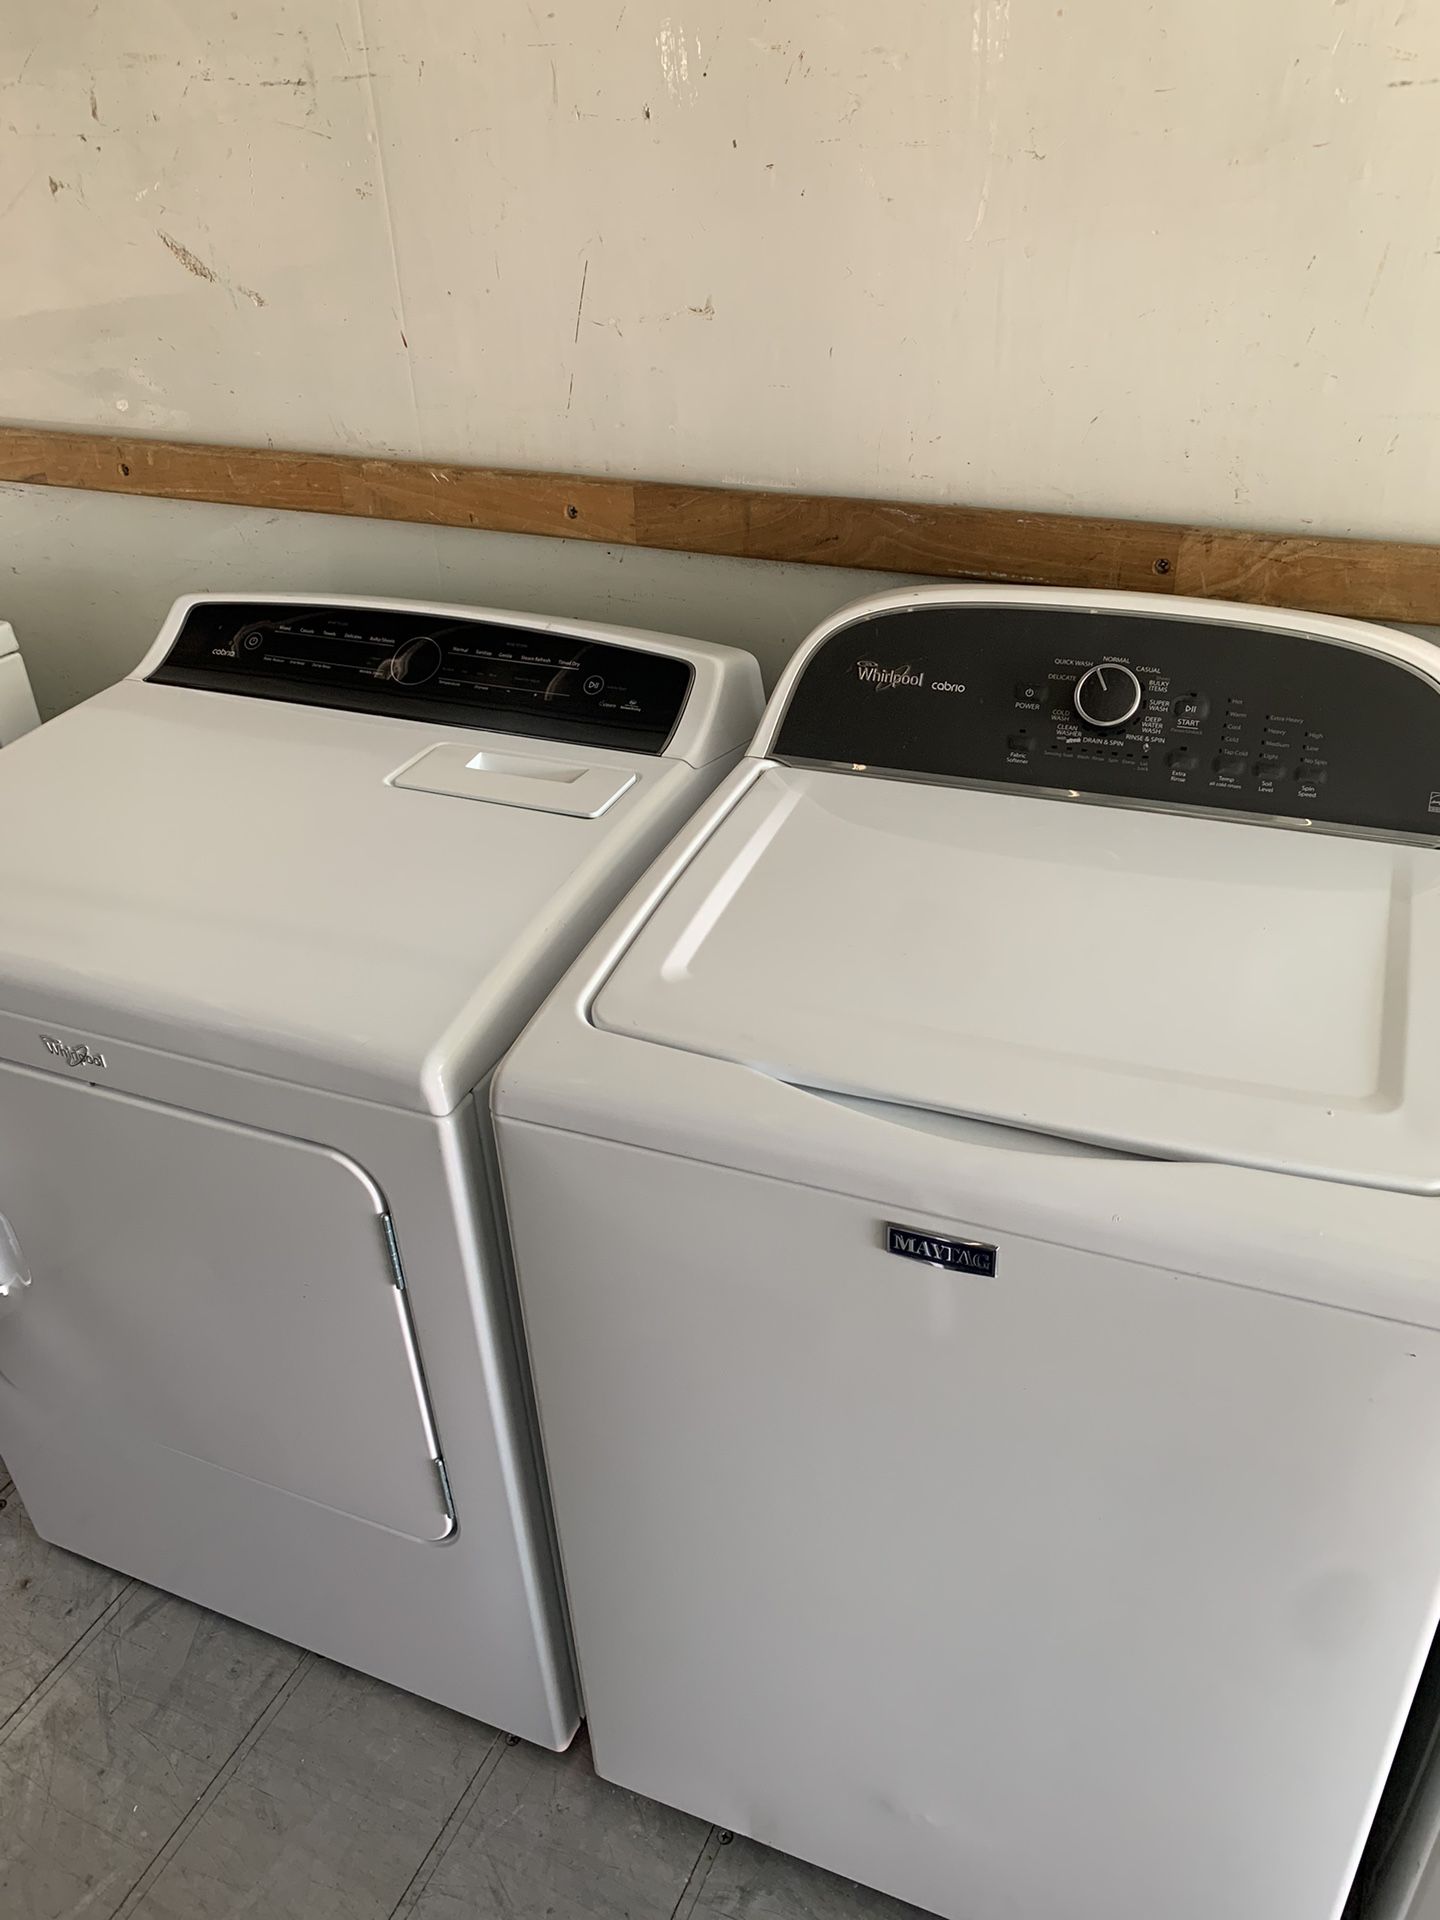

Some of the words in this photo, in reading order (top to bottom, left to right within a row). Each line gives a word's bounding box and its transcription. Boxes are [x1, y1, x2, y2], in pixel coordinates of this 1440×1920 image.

[1054, 658, 1074, 666] QUICK
[1103, 656, 1130, 664] NORMAL
[1136, 665, 1161, 674] CASUAL
[858, 666, 924, 689] Whirlpool
[931, 681, 966, 693] cabrio
[1048, 673, 1077, 681] DELICATE
[1015, 702, 1040, 710] POWER
[1149, 699, 1170, 707] SUPER
[1052, 709, 1070, 717] COLD
[1177, 719, 1201, 727] START
[1056, 729, 1082, 737] WASHER
[1082, 737, 1103, 745] DRAIN
[1126, 733, 1144, 742] RINSE
[1151, 736, 1166, 744] SPIN
[40, 1039, 107, 1069] Whirlpool
[894, 1233, 991, 1270] MAYTAG
